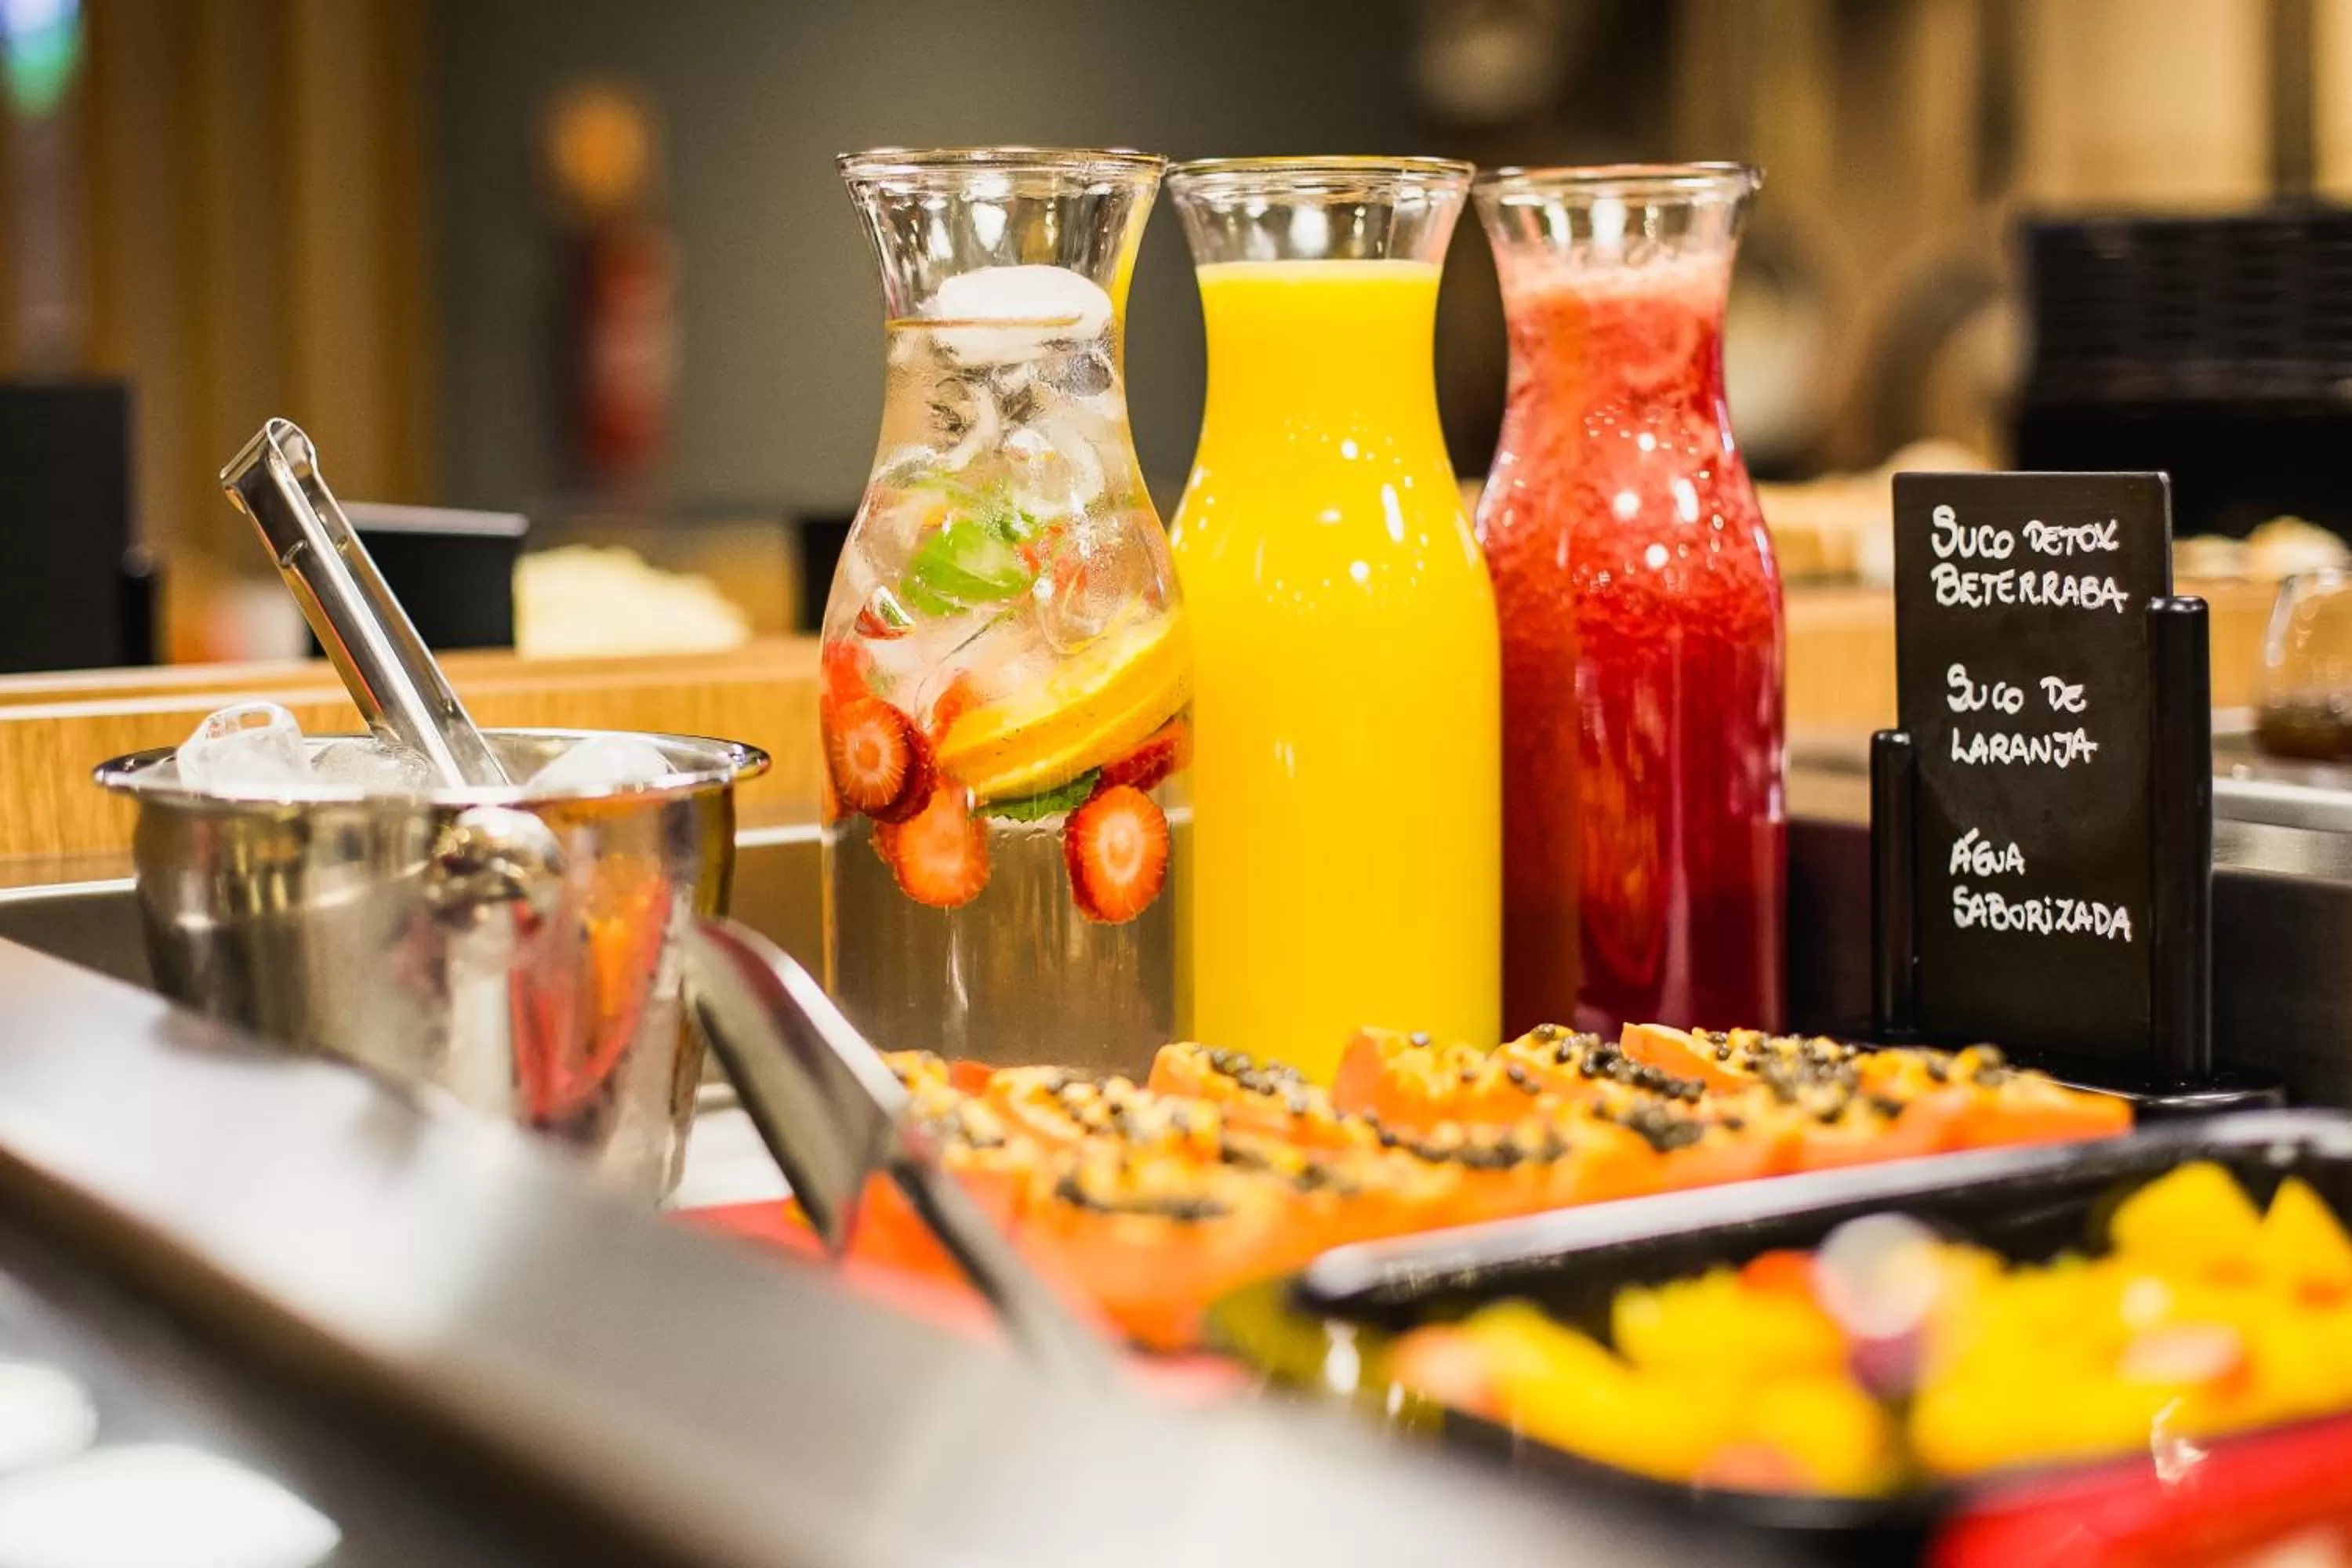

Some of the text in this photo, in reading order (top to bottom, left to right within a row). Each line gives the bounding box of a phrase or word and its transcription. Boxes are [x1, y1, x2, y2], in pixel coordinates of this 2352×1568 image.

[2021, 517, 2120, 557] DETOX
[1930, 561, 2130, 614] BETERRABA
[2039, 675, 2088, 714] DE
[1950, 726, 2100, 769] LARANJA
[1948, 826, 2026, 877] ÁGUA
